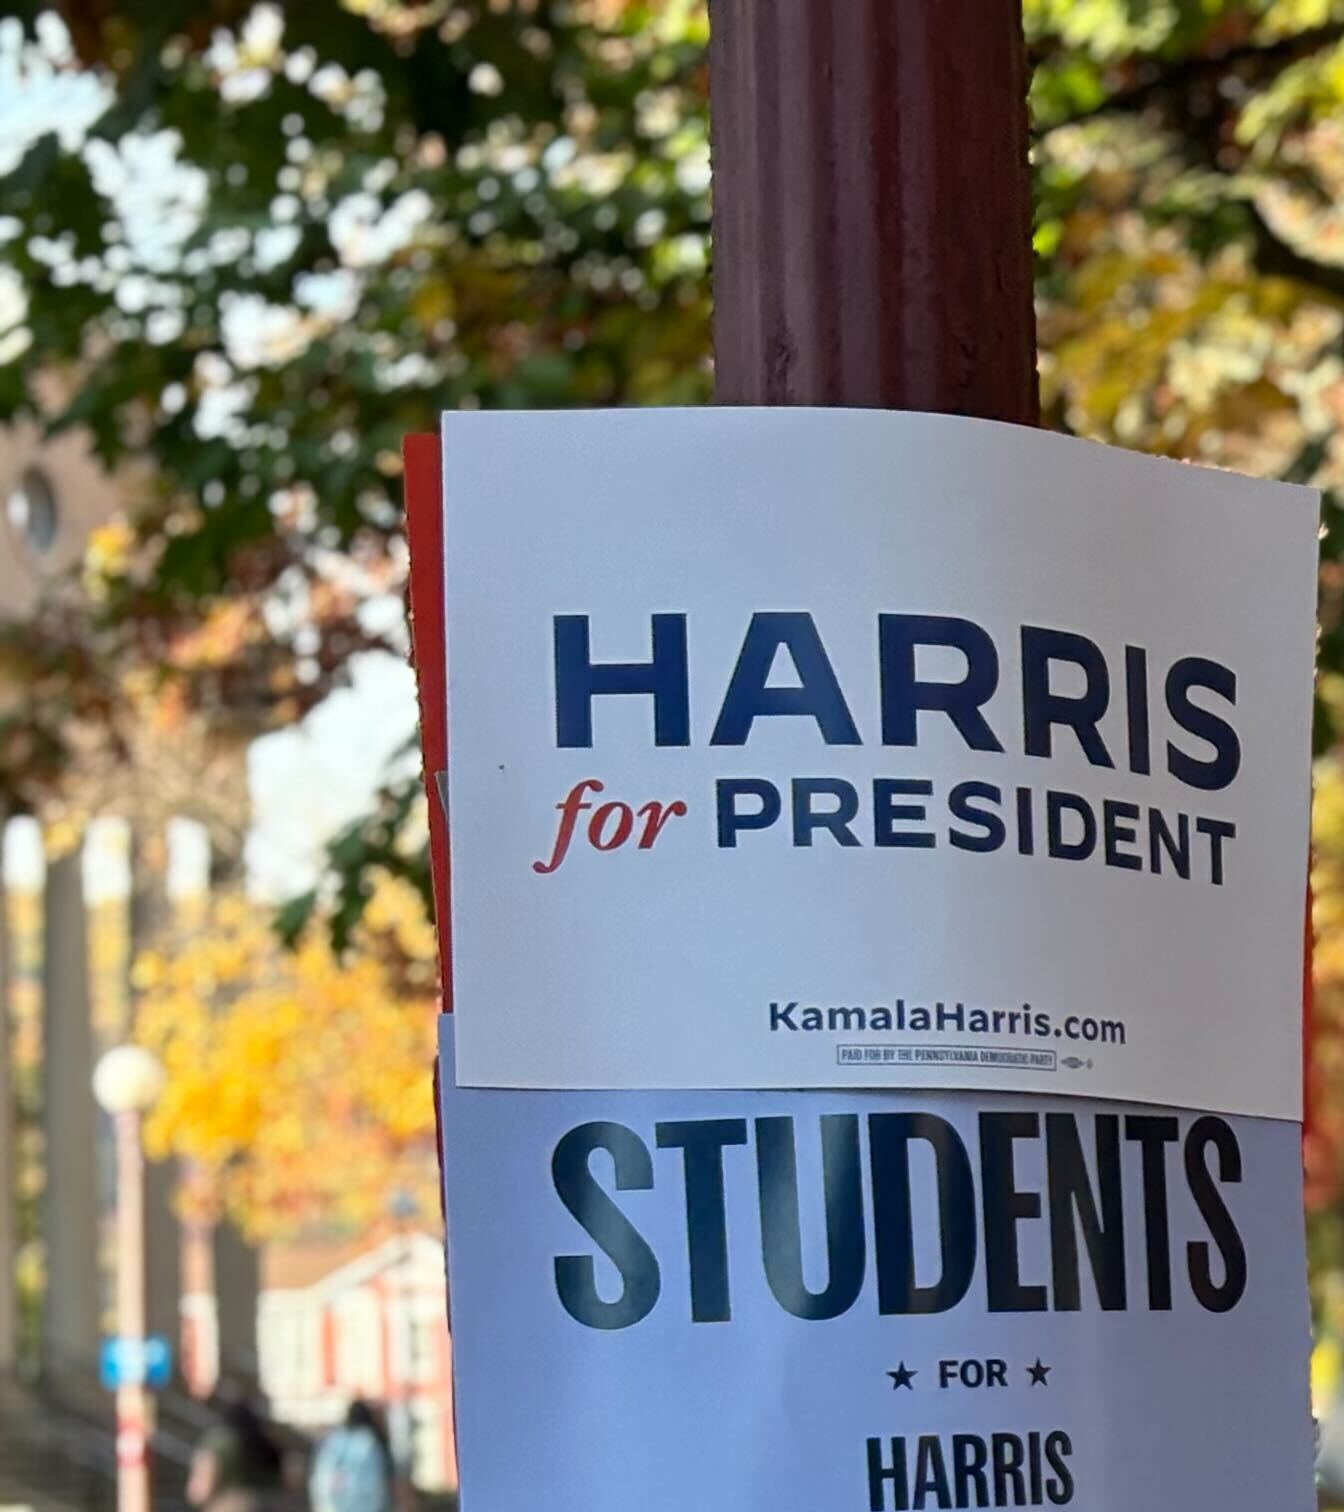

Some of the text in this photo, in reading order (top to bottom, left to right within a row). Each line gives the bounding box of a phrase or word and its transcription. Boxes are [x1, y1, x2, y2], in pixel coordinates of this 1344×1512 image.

[553, 611, 1242, 792] HARRIS
[532, 777, 1238, 886] for PRESIDENT
[768, 999, 1127, 1045] KamalaHarris.com
[551, 1111, 1248, 1330] STUDENTS
[938, 1358, 1009, 1389] FOR
[866, 1430, 1074, 1512] HARRIS
